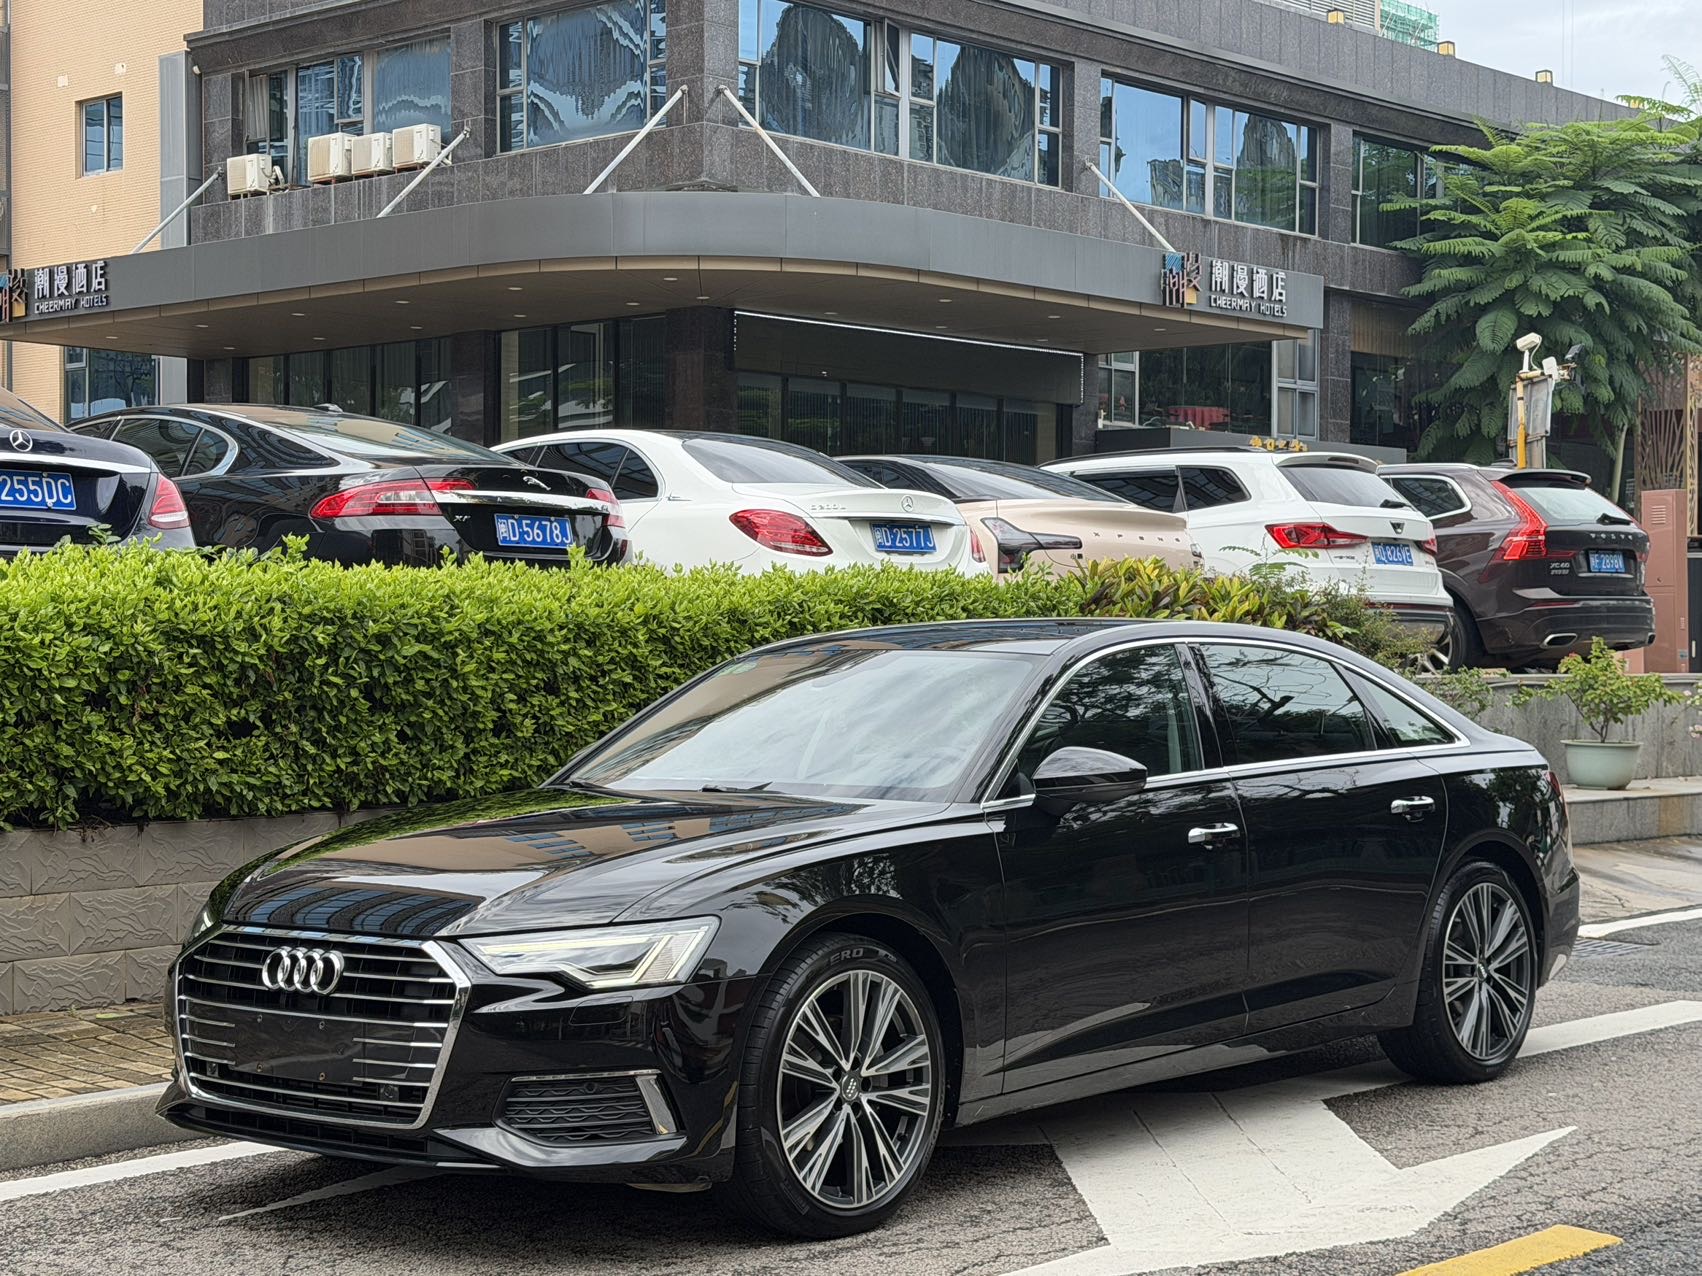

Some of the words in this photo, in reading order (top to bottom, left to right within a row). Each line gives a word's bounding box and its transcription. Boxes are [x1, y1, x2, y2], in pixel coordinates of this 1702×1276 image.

[34, 260, 106, 299] 潮漫酒店
[1211, 259, 1287, 303] 潮漫酒店
[34, 299, 76, 314] CHEERMAY
[80, 294, 107, 308] HOTELS
[1210, 294, 1257, 312] CHEERMAY
[1260, 302, 1288, 317] HOTELS
